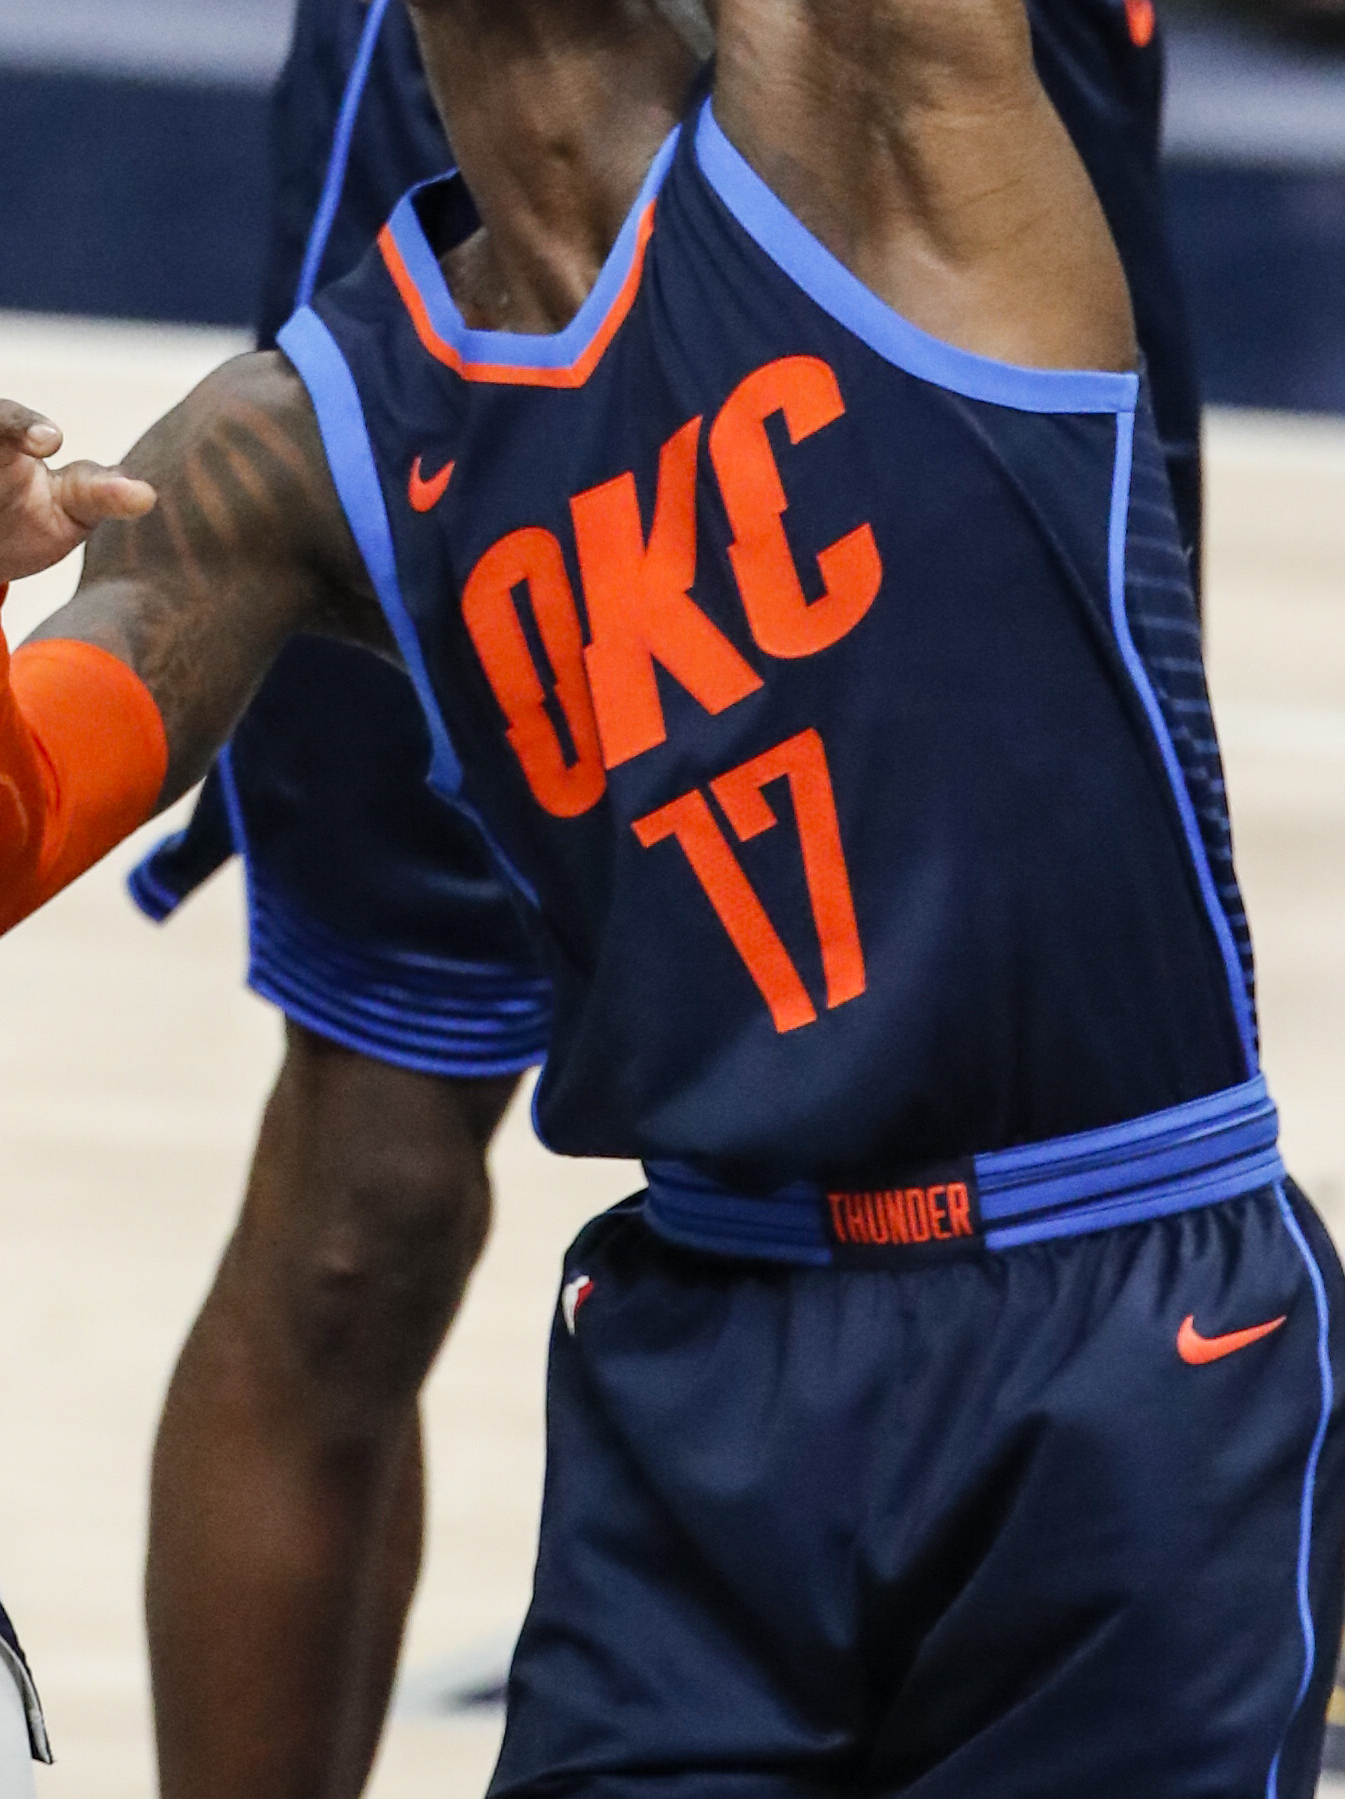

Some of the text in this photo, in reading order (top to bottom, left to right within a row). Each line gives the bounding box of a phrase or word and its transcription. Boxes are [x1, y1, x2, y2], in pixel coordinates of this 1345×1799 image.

[461, 354, 883, 818] OKC
[631, 728, 867, 1034] 17
[827, 1181, 974, 1245] THUNDER
